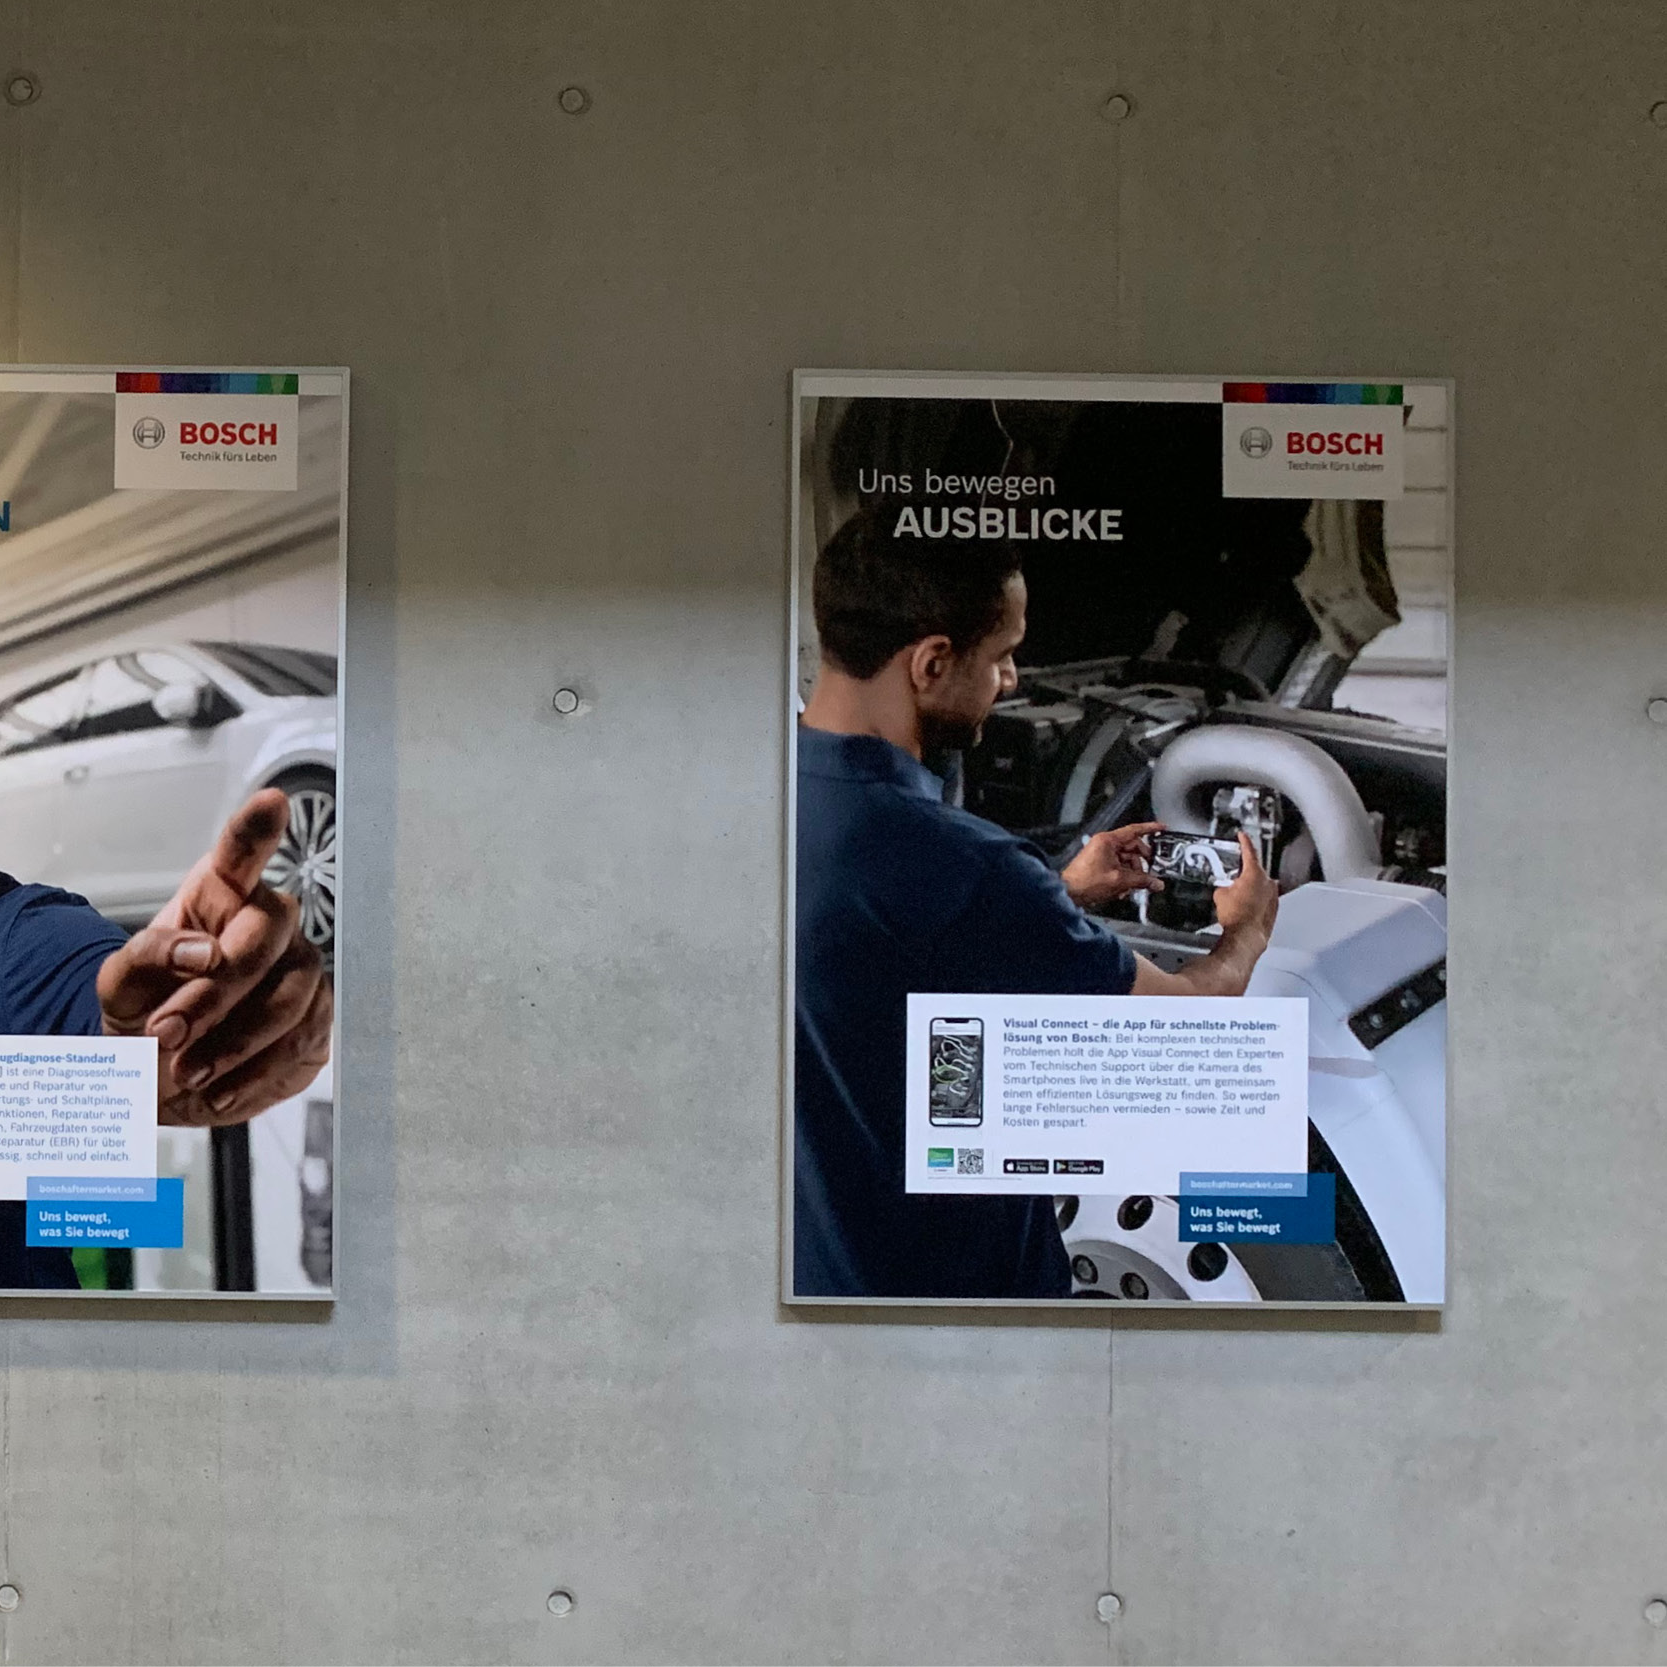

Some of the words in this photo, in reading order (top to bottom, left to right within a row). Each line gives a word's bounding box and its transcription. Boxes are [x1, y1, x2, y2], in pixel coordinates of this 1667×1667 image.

[179, 421, 278, 447] BOSCH
[1286, 430, 1384, 457] BOSCH
[179, 451, 221, 461] Technik
[223, 452, 243, 461] fürs
[245, 452, 278, 462] Leben
[859, 468, 912, 493] Uns
[925, 468, 1054, 501] bewegen
[893, 506, 1123, 540] AUSBLICKE
[1003, 1018, 1037, 1028] Visual
[1041, 1018, 1087, 1028] Connect
[1102, 1019, 1119, 1029] die
[1123, 1020, 1146, 1030] App
[1150, 1019, 1165, 1029] für
[1170, 1020, 1226, 1030] schnellste
[1003, 1033, 1042, 1044] lösung
[1116, 1033, 1134, 1043] Bei
[1137, 1034, 1197, 1044] komplexen
[1200, 1035, 1266, 1044] technischen
[1003, 1046, 1060, 1056] Problemen
[1064, 1047, 1083, 1056] holt
[1088, 1047, 1103, 1057] die
[1107, 1047, 1128, 1058] App
[1131, 1047, 1162, 1057] Visual
[1165, 1047, 1209, 1058] Connect
[1213, 1048, 1233, 1058] den
[1236, 1049, 1283, 1059] Experten
[1003, 1062, 1025, 1070] vom
[1030, 1060, 1096, 1070] Technischen
[1101, 1062, 1145, 1072] Support
[1149, 1062, 1173, 1073] über
[1177, 1063, 1194, 1072] die
[1198, 1063, 1238, 1072] Kamera
[1242, 1062, 1262, 1072] des
[6, 1067, 18, 1076] ist
[48, 1067, 141, 1079] Diagnosesoftware
[9, 1081, 29, 1090] und
[33, 1080, 84, 1091] Reparatur
[90, 1083, 107, 1091] von
[1003, 1075, 1075, 1085] Smartphones
[1080, 1076, 1097, 1086] live
[1101, 1075, 1110, 1084] in
[1114, 1076, 1131, 1085] die
[1194, 1076, 1210, 1086] um
[1214, 1078, 1275, 1088] gemeinsam
[37, 1096, 57, 1104] und
[1002, 1090, 1032, 1098] einen
[1036, 1089, 1092, 1098] effizienten
[1096, 1090, 1161, 1101] Lösungsweg
[1165, 1092, 1177, 1100] zu
[1222, 1090, 1236, 1100] So
[1239, 1092, 1279, 1100] werden
[1003, 1103, 1031, 1114] lange
[1036, 1103, 1109, 1113] Fehlersuchen
[1113, 1104, 1170, 1113] vermieden
[1185, 1106, 1216, 1114] sowie
[1220, 1104, 1240, 1114] Zeit
[1244, 1105, 1265, 1114] und
[110, 1111, 130, 1119] und
[10, 1122, 87, 1134] Fahrzeugdaten
[91, 1125, 121, 1133] sowie
[1003, 1117, 1039, 1127] Kosten
[49, 1136, 79, 1147] (EBR)
[83, 1137, 97, 1146] für
[102, 1138, 125, 1147] über
[26, 1150, 62, 1160] schnell
[66, 1151, 86, 1161] und
[39, 1211, 61, 1221] Uns
[1190, 1206, 1212, 1217] Uns
[39, 1228, 61, 1236] was
[65, 1226, 83, 1237] Sie
[87, 1226, 129, 1240] bewegt
[1190, 1223, 1214, 1233] was
[1216, 1221, 1234, 1233] Sie
[1238, 1221, 1281, 1236] bewegt
